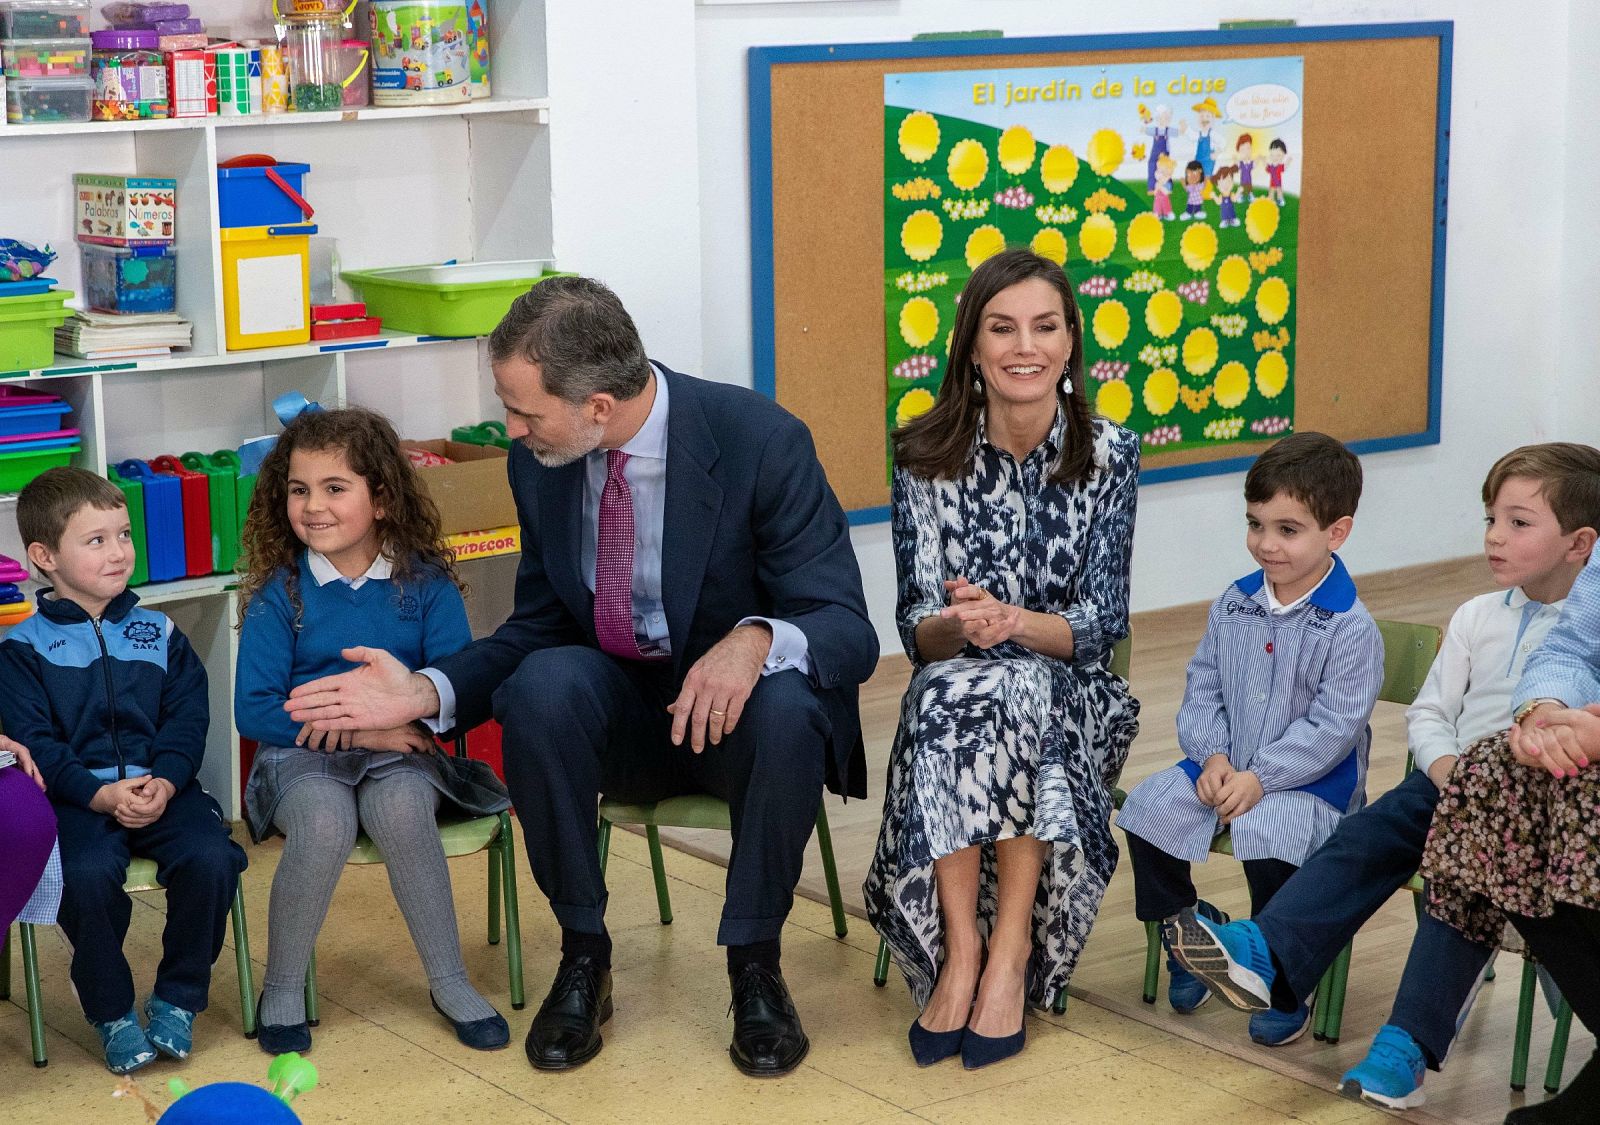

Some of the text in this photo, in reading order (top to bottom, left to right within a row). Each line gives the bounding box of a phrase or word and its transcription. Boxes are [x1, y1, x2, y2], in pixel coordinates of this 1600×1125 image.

[298, 2, 321, 10] JOVI
[972, 74, 1226, 107] El jardín de la clase
[85, 202, 119, 218] Palabras
[1307, 619, 1327, 631] SAFA
[132, 643, 160, 651] SAFA
